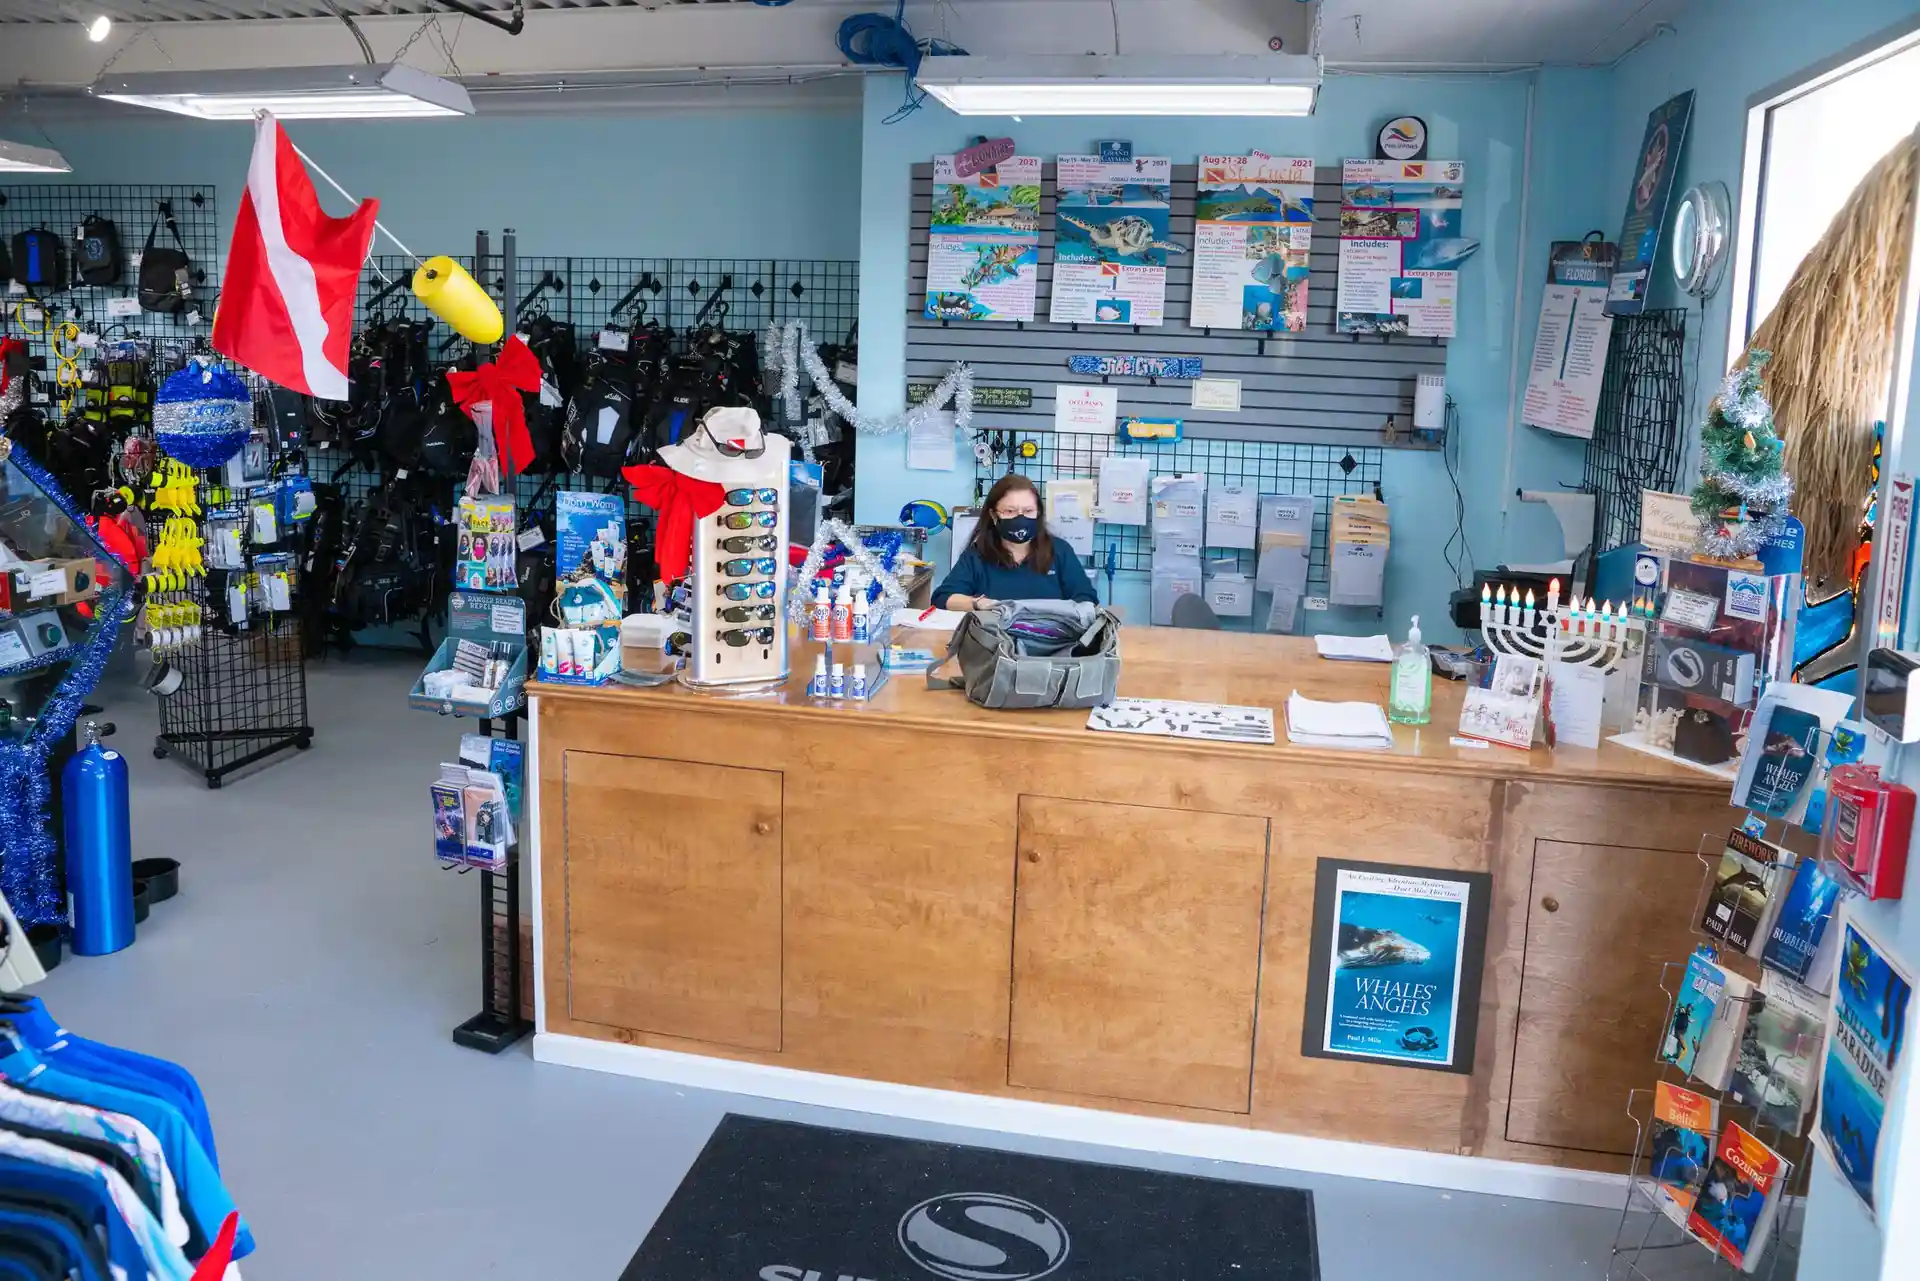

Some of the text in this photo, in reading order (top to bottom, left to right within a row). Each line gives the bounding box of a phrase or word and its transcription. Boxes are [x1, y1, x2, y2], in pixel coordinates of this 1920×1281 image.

[1018, 158, 1038, 166] 2021
[1203, 156, 1220, 165] Aug
[1222, 156, 1232, 164] 21
[1197, 237, 1232, 246] Includes:
[1350, 240, 1389, 248] Includes:
[1058, 252, 1096, 262] Includes:
[1566, 267, 1597, 282] FLORIDA
[468, 596, 516, 606] RANGER READY
[1762, 774, 1797, 792] ANGELS
[1730, 831, 1779, 864] FIREWORKS
[1358, 874, 1384, 883] Exciting
[1388, 877, 1418, 886] Adventure
[1429, 888, 1442, 896] This
[1705, 917, 1723, 935] PAUL
[1730, 929, 1748, 948] MILA
[1356, 977, 1437, 1000] WHALES'
[1355, 994, 1431, 1016] ANGELS
[1842, 1004, 1876, 1054] KILLER
[1347, 1034, 1360, 1042] Paul
[1368, 1036, 1382, 1044] Mila
[1836, 1020, 1886, 1098] PARADISE
[1668, 1108, 1699, 1128] Belize
[1726, 1147, 1768, 1188] Cozumel
